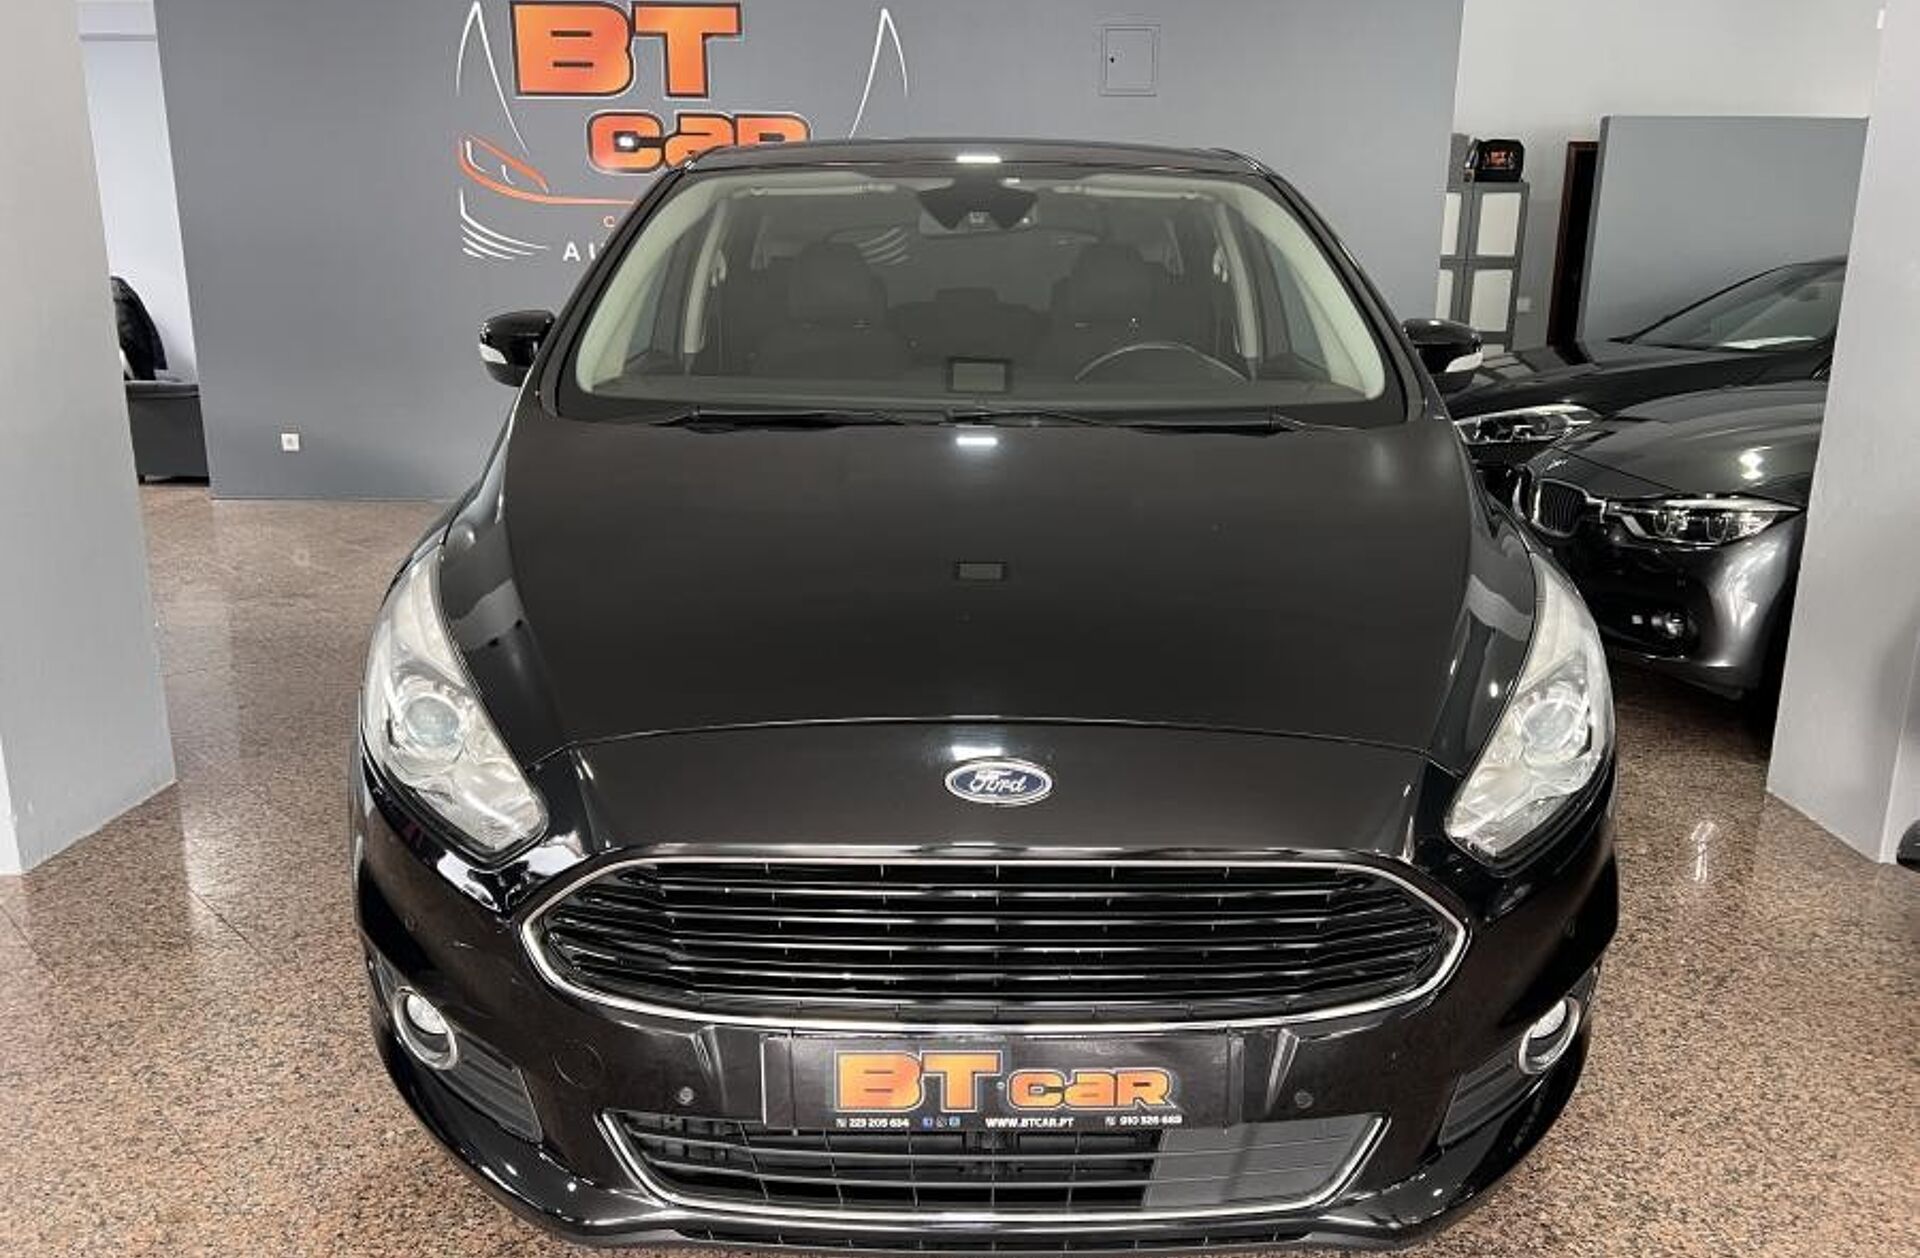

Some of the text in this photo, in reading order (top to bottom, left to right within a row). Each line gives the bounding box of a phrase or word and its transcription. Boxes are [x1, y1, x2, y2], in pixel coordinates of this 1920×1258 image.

[510, 1, 743, 98] BT
[969, 768, 1028, 794] Ford
[835, 1050, 1002, 1112] BT
